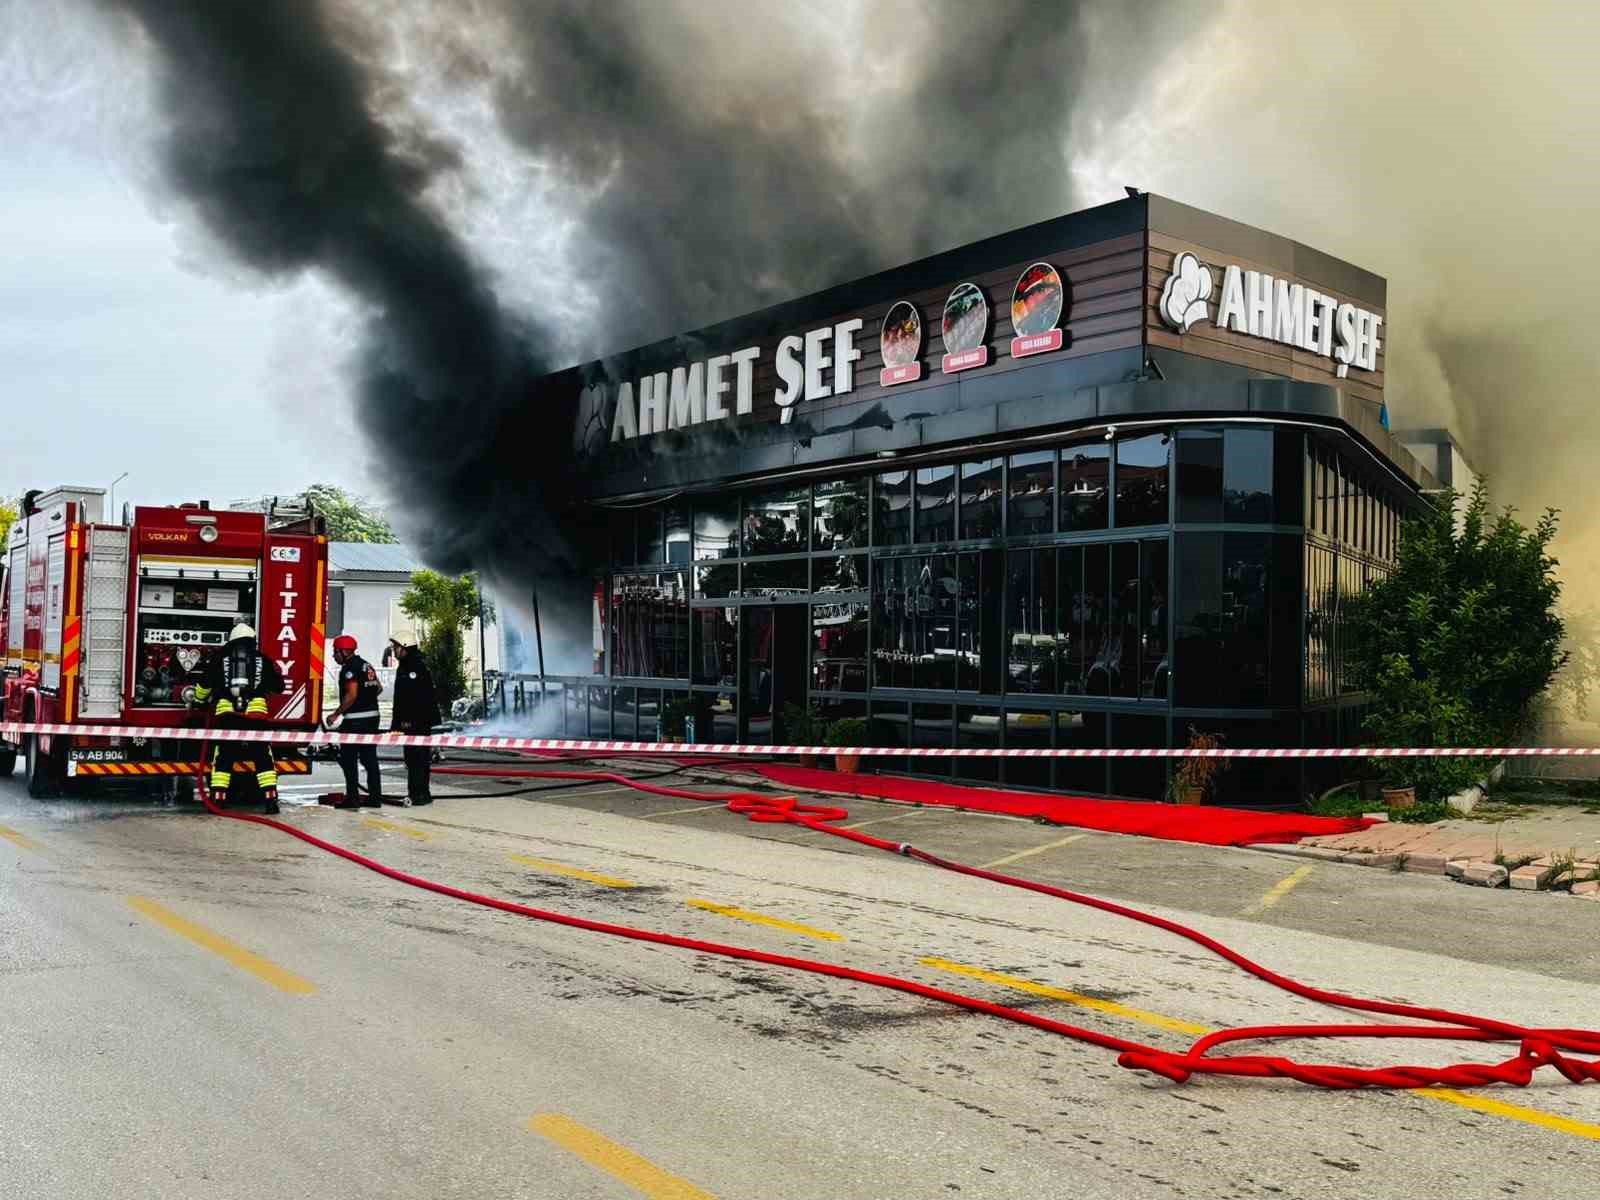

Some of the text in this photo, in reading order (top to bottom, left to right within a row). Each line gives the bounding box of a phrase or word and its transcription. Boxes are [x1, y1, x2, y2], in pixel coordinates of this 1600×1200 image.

[1216, 264, 1383, 379] AHMET ŞEF
[610, 318, 863, 443] AHMET ŞEF
[147, 532, 188, 541] VOLKAN
[71, 750, 124, 760] 54 AB 904
